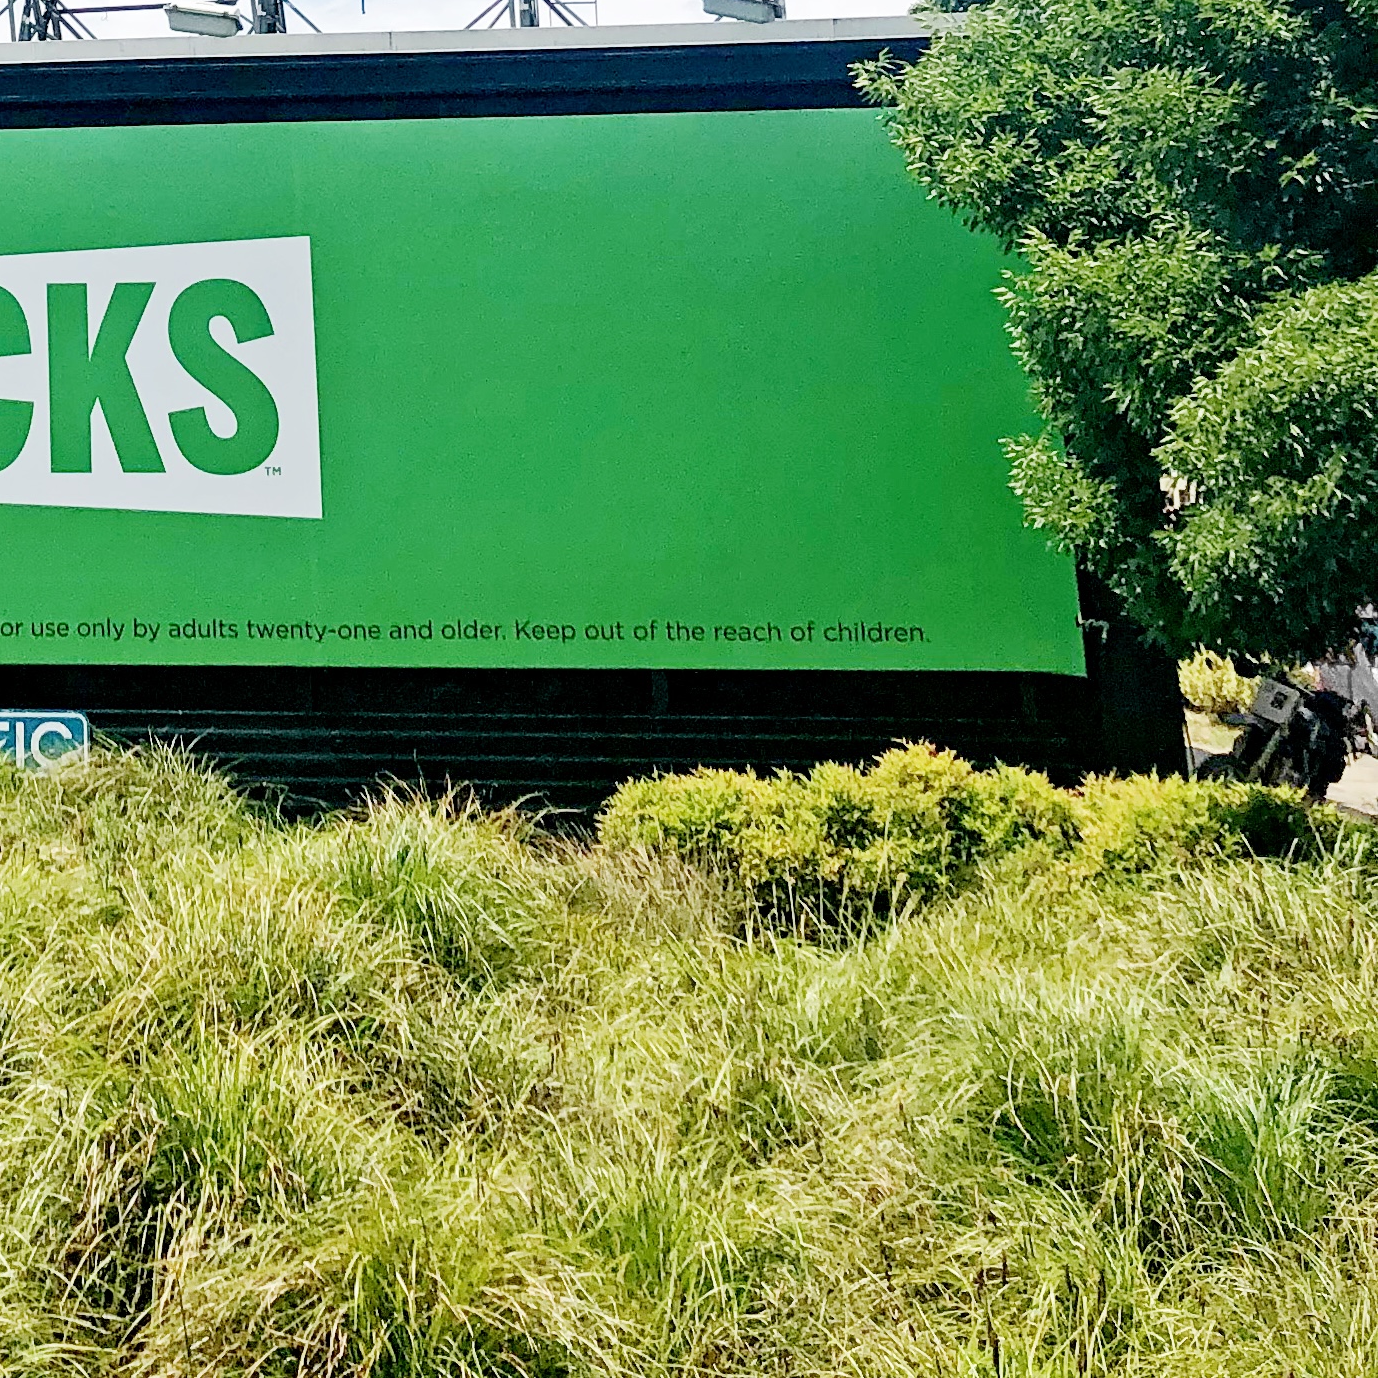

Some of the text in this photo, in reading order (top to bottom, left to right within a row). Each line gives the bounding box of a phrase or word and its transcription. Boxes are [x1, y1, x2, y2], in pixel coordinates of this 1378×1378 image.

[31, 621, 70, 638] use
[76, 616, 125, 642] only
[133, 617, 161, 643] by
[168, 617, 239, 639] adults
[246, 619, 382, 644] twenty-one
[389, 619, 433, 640] and
[440, 618, 507, 641] older.
[514, 618, 577, 645] Keep
[584, 621, 625, 642] out
[633, 619, 658, 642] of
[665, 620, 706, 642] the
[713, 621, 783, 643] reach
[790, 620, 816, 643] of
[823, 618, 932, 643] children.
